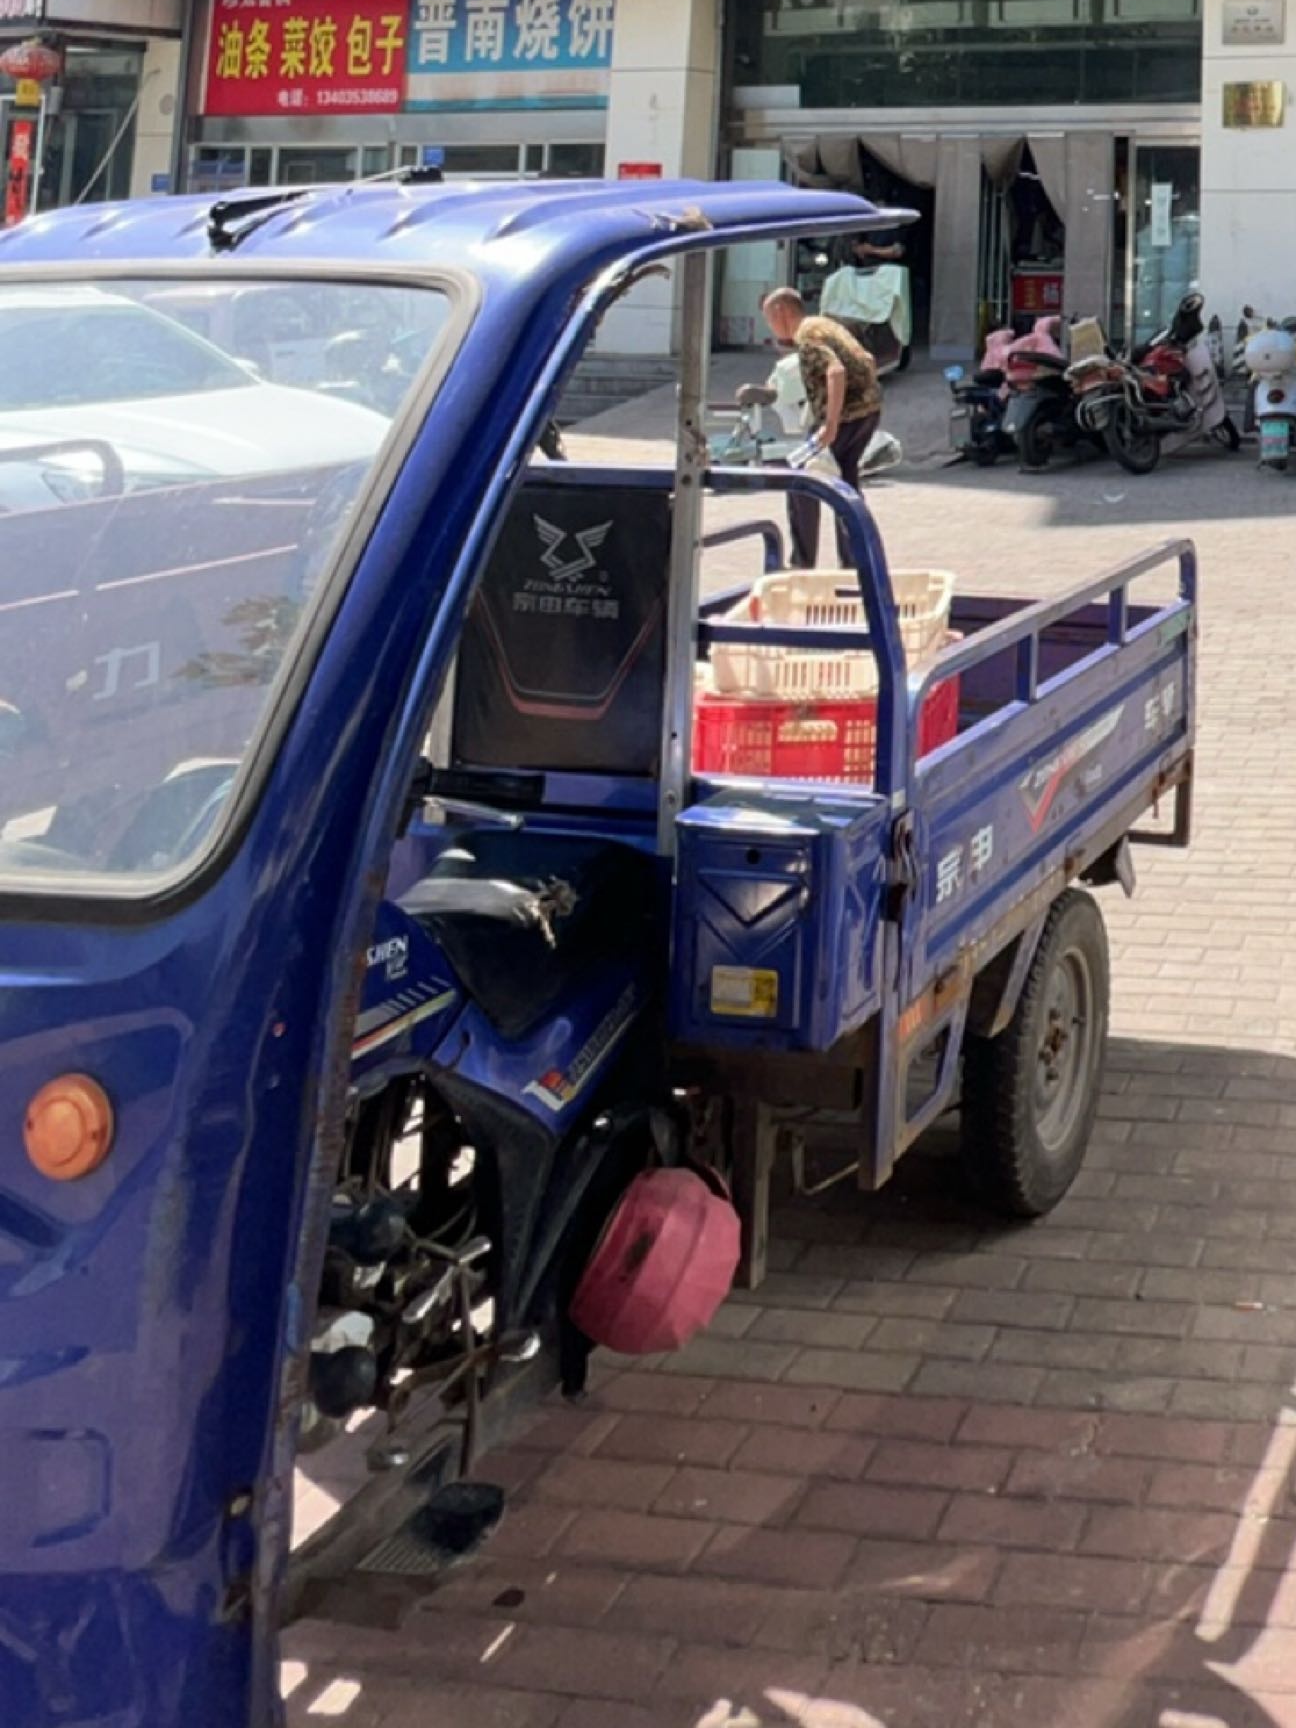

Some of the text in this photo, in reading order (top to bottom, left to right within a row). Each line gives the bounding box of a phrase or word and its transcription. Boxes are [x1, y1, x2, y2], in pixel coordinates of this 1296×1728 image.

[216, 14, 404, 79] 油条 菜饺 包子
